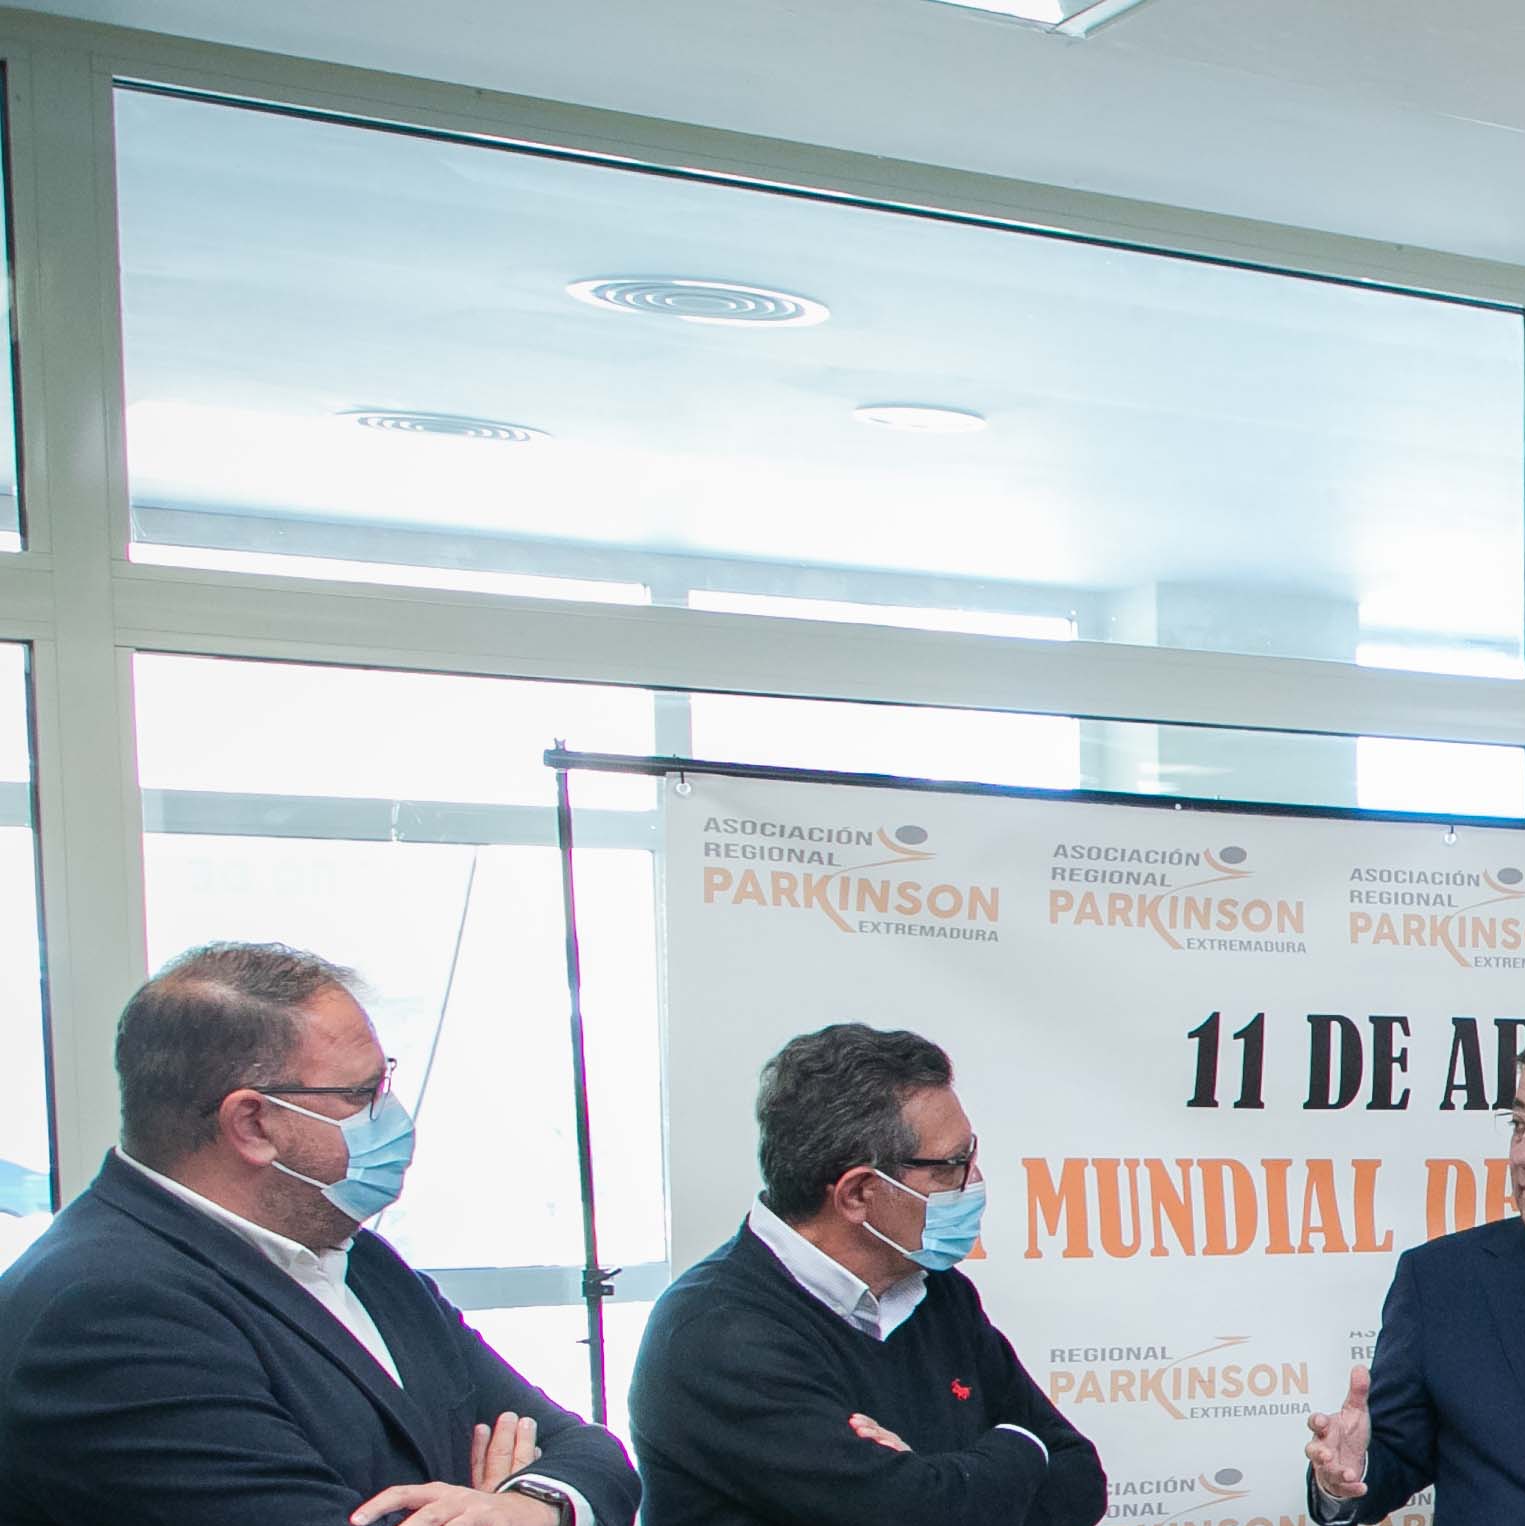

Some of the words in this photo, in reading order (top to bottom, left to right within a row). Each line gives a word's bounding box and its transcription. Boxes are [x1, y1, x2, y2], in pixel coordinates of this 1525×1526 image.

[703, 815, 874, 847] ASOCIACIÓN
[703, 841, 842, 867] REGIONAL
[1052, 843, 1201, 867] ASOCIACIÓN
[1050, 866, 1173, 888] REGIONAL
[1349, 867, 1481, 889] ASOCIACIÓN
[702, 866, 1000, 933] PARKINSON
[1348, 890, 1459, 908] REGIONAL
[1048, 889, 1305, 950] PARKINSON
[857, 921, 1000, 942] EXTREMADURA
[1186, 937, 1308, 954] EXTREMADURA
[1186, 1011, 1266, 1109] 11
[1303, 1014, 1412, 1111] DE
[1021, 1157, 1395, 1260] MUNDIAL
[1050, 1346, 1174, 1363] REGIONAL
[1049, 1361, 1310, 1420] PARKINSON
[1189, 1402, 1312, 1420] EXTREMADURA
[1107, 1476, 1196, 1497] IACIÓN
